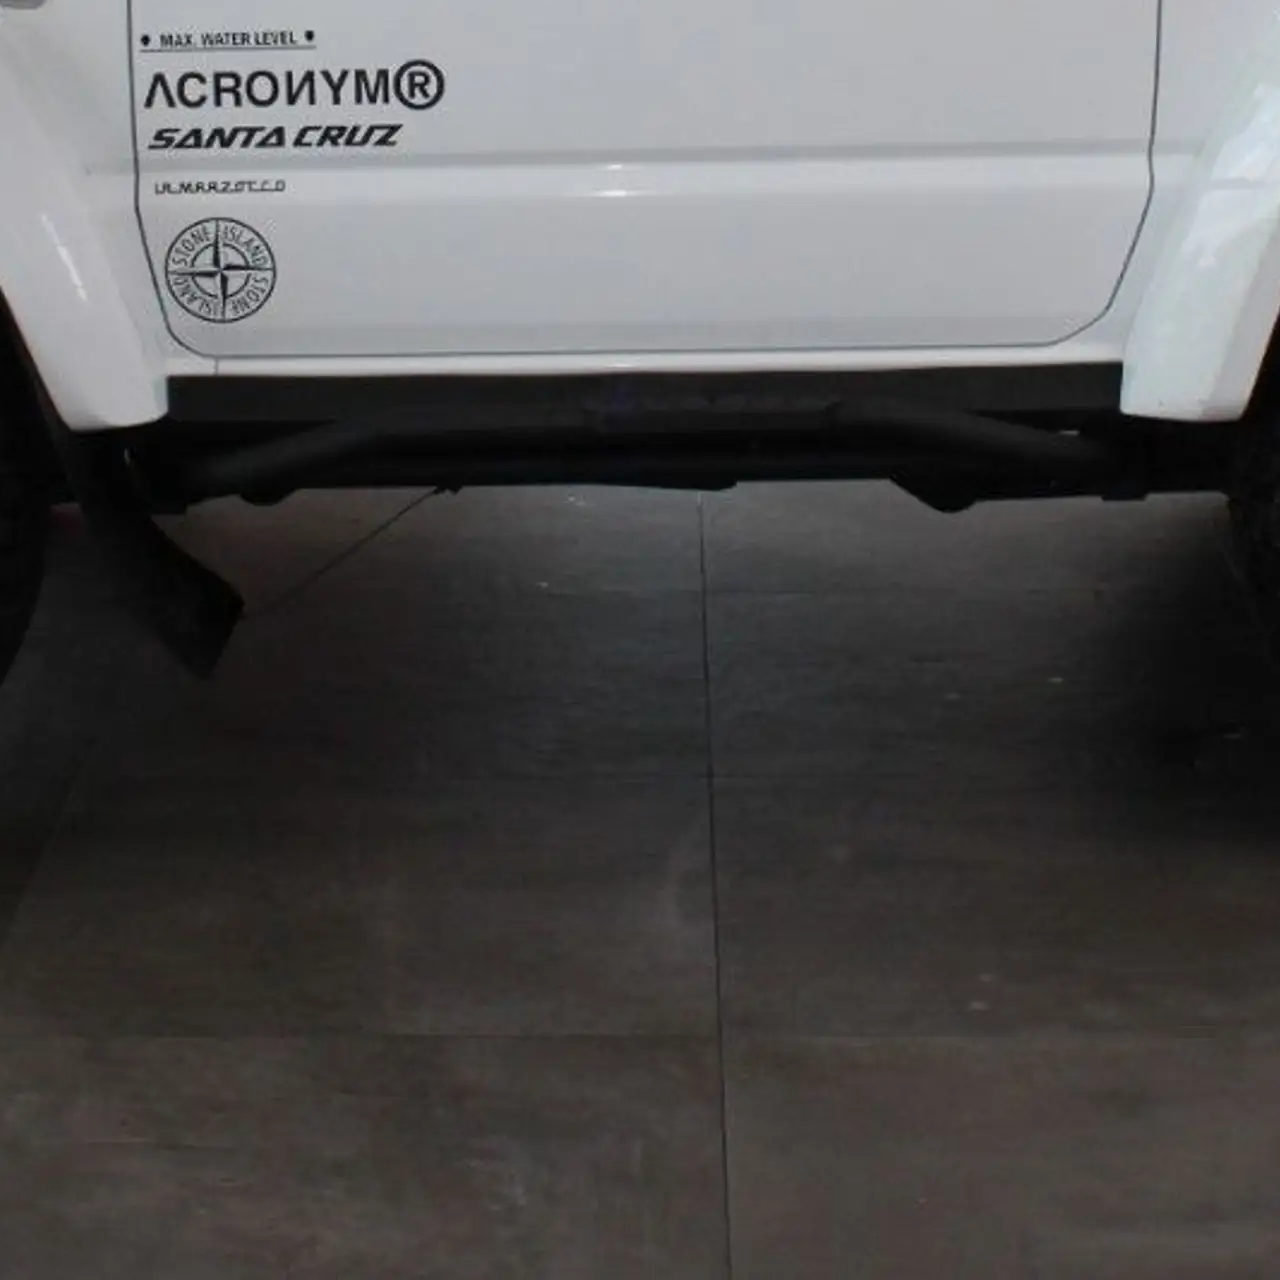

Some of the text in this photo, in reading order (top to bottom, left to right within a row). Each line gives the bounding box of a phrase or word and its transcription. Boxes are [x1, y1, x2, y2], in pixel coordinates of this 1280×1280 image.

[201, 32, 252, 46] WATER
[254, 30, 299, 46] LEVEL
[147, 123, 404, 150] SANTA CRUZ
[172, 224, 269, 267] STONE ISLAND
[231, 276, 270, 318] STONE
